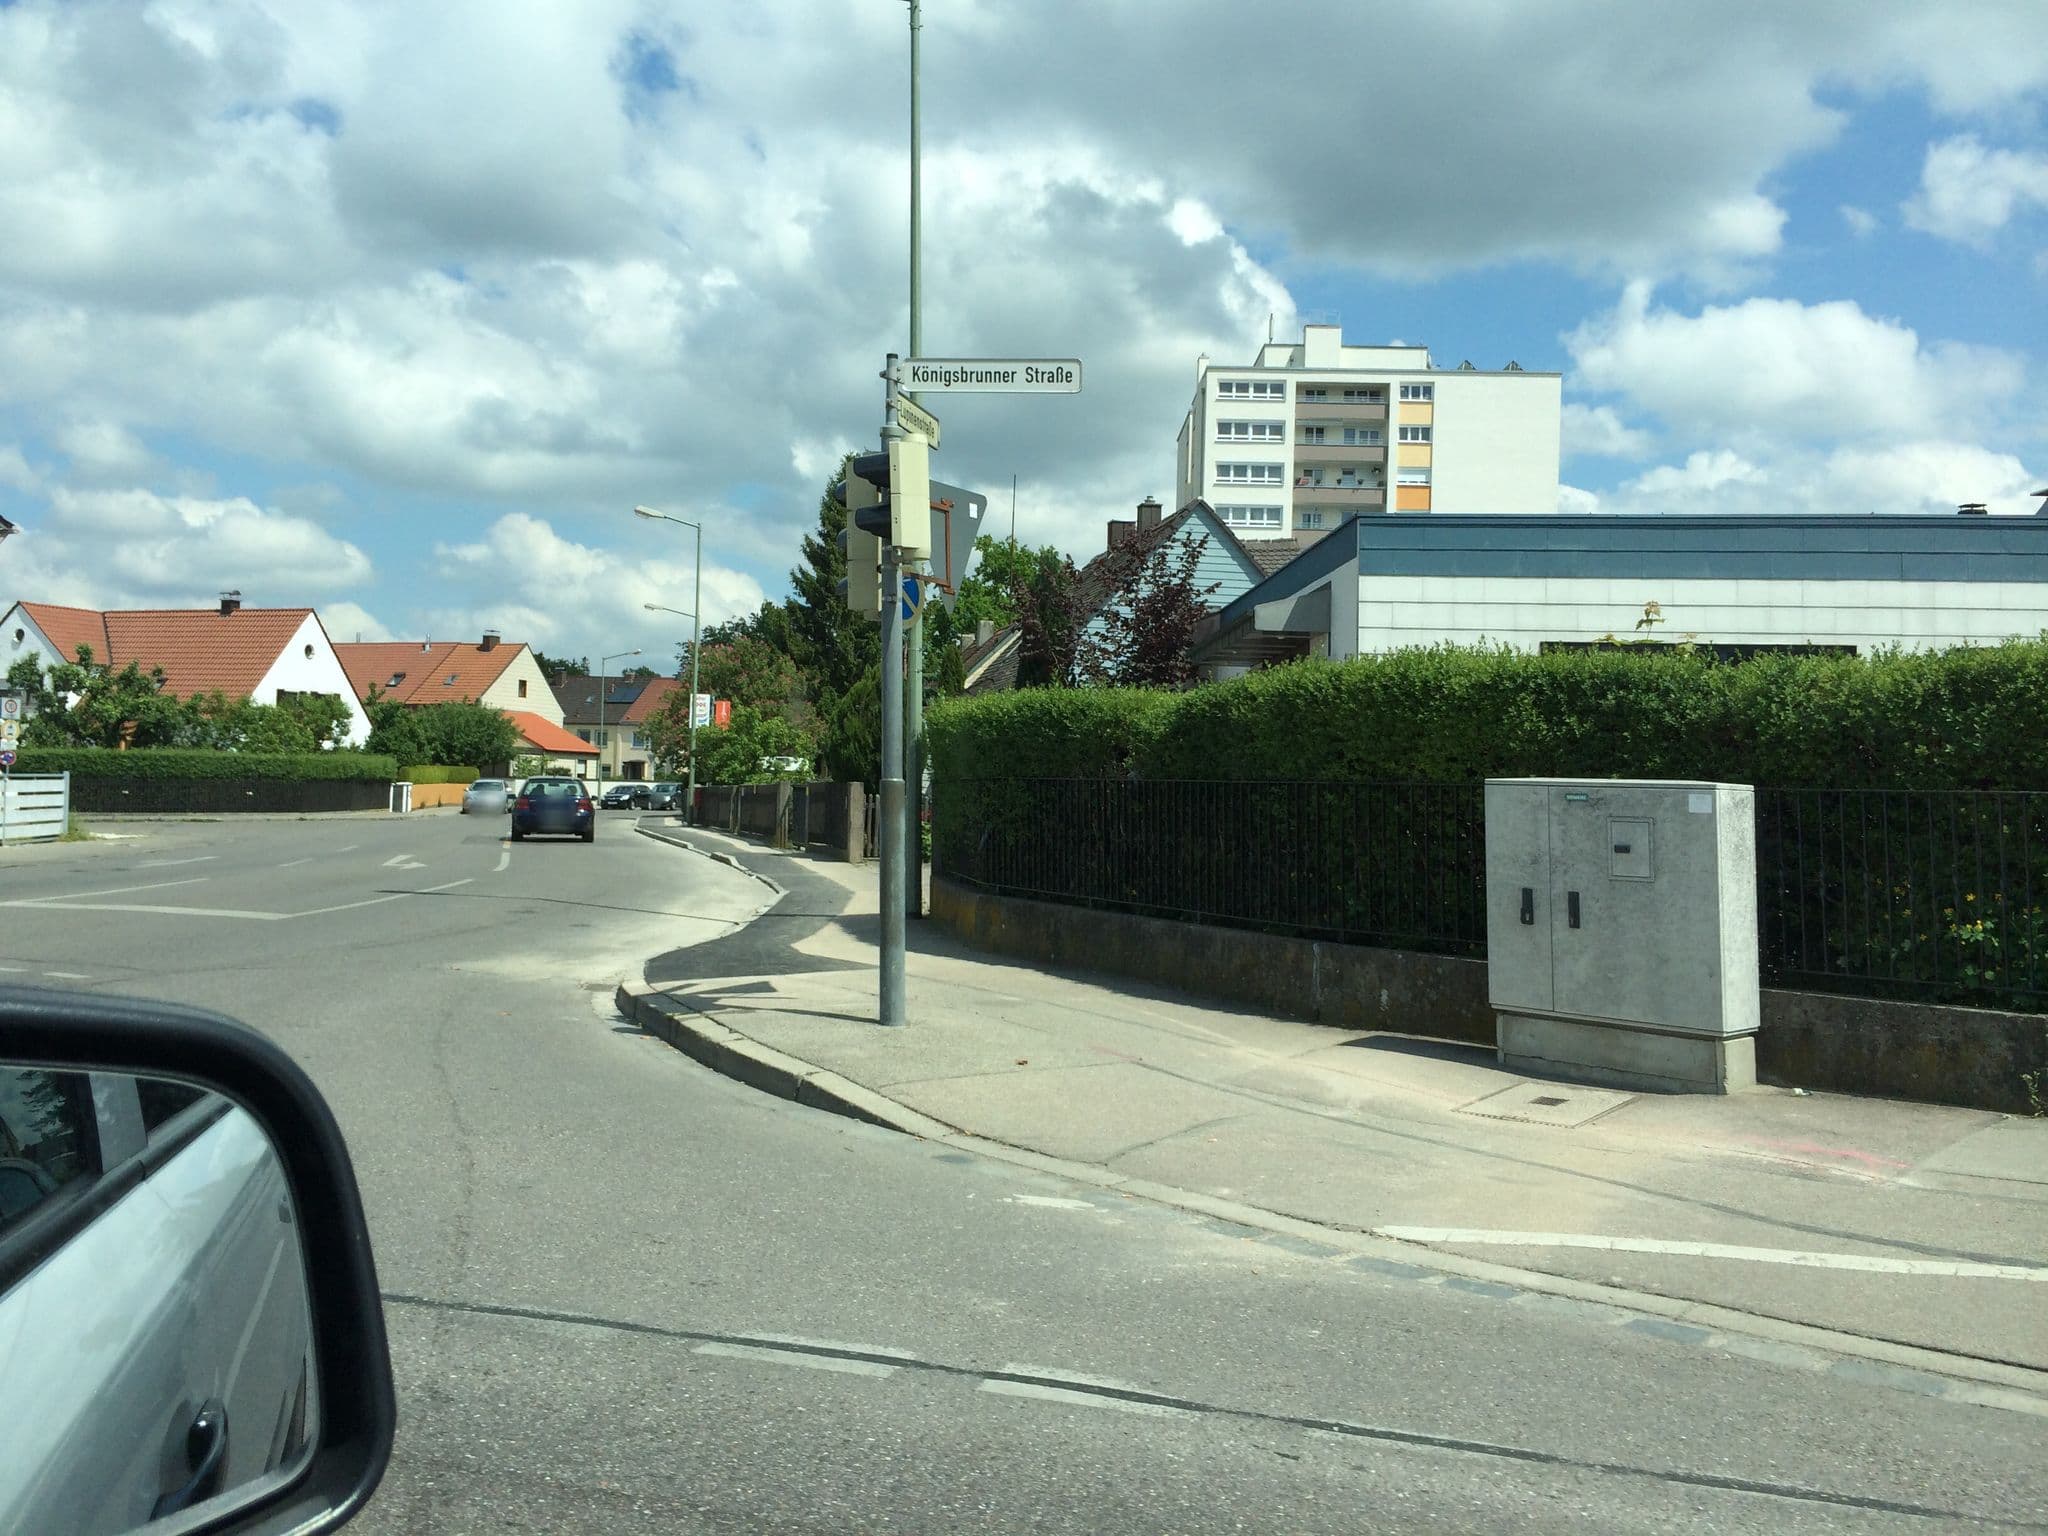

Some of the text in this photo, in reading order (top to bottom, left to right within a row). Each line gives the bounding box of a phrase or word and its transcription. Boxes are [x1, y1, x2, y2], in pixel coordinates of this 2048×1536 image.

[912, 366, 1073, 387] Königsbrunner Straße
[900, 401, 935, 439] Lupinenstraße
